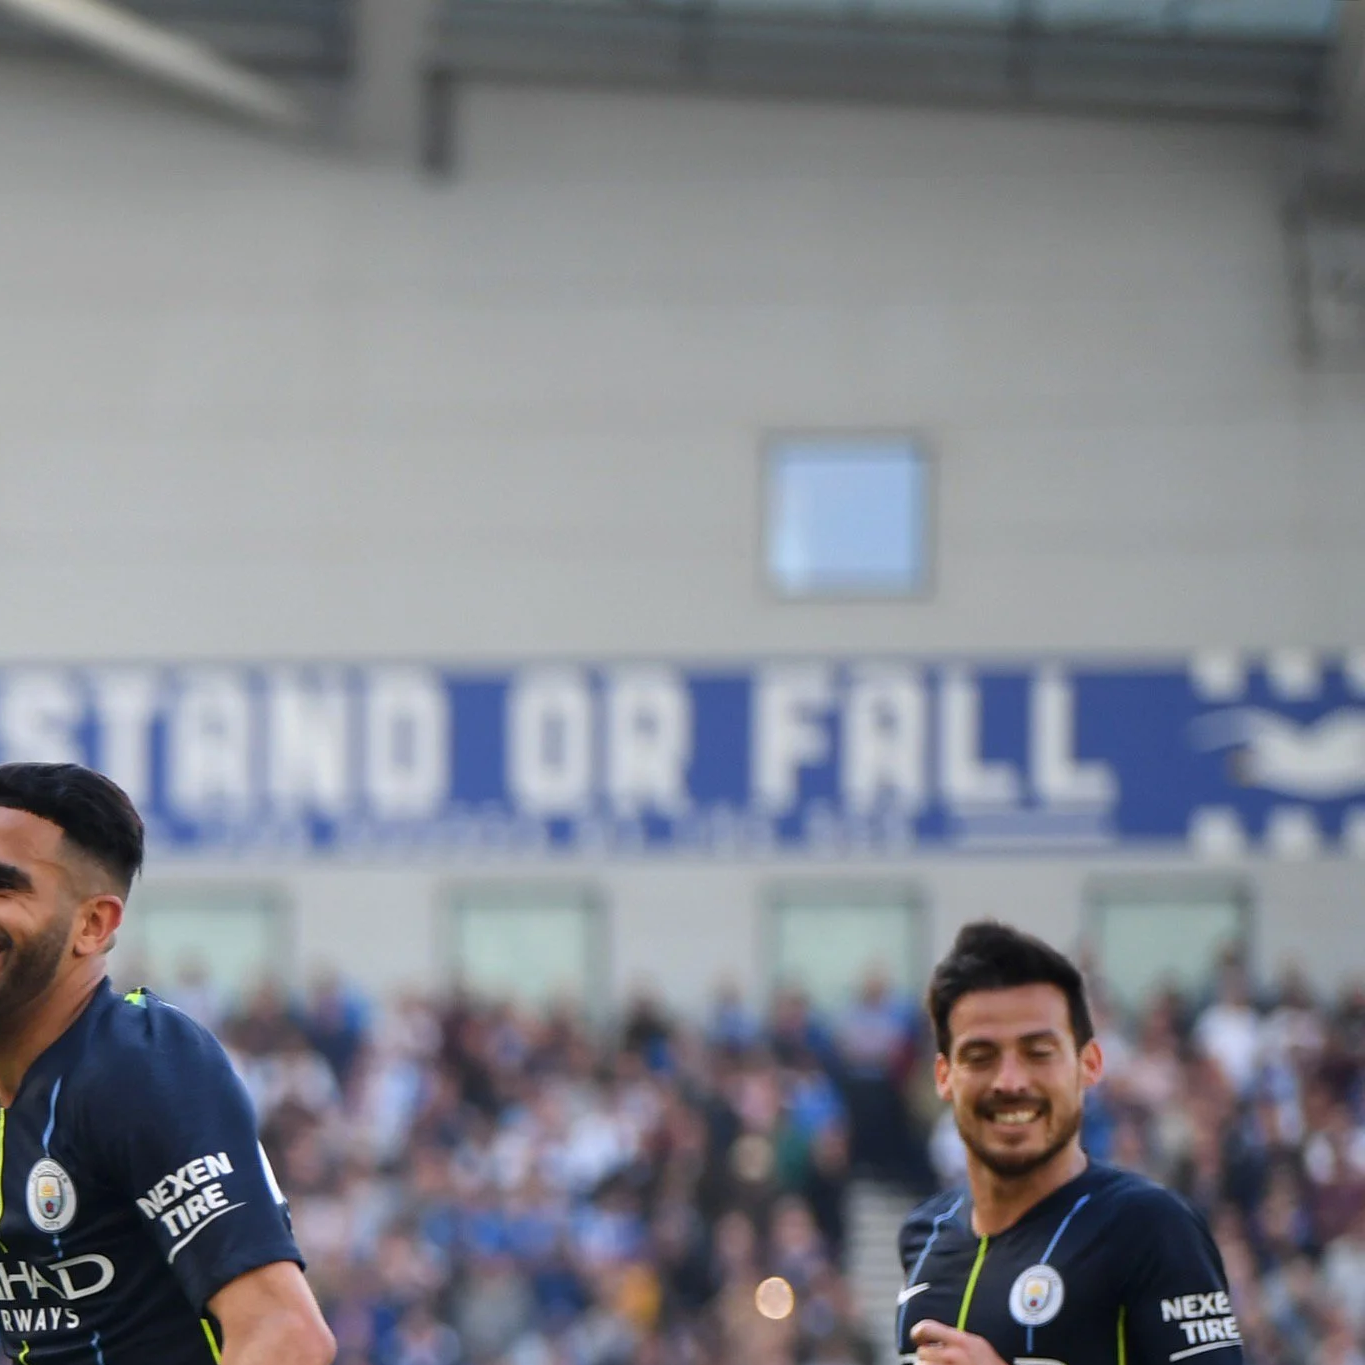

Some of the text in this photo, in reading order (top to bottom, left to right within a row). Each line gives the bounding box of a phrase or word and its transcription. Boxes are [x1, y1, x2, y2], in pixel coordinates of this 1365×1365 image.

[505, 662, 693, 816] OR
[749, 662, 1117, 816] FALL
[136, 1152, 235, 1220] NEXEN
[160, 1182, 230, 1238] TIRE
[0, 1307, 81, 1332] RWAYS
[1160, 1290, 1232, 1323] NEXE
[1179, 1316, 1241, 1345] TIRE
